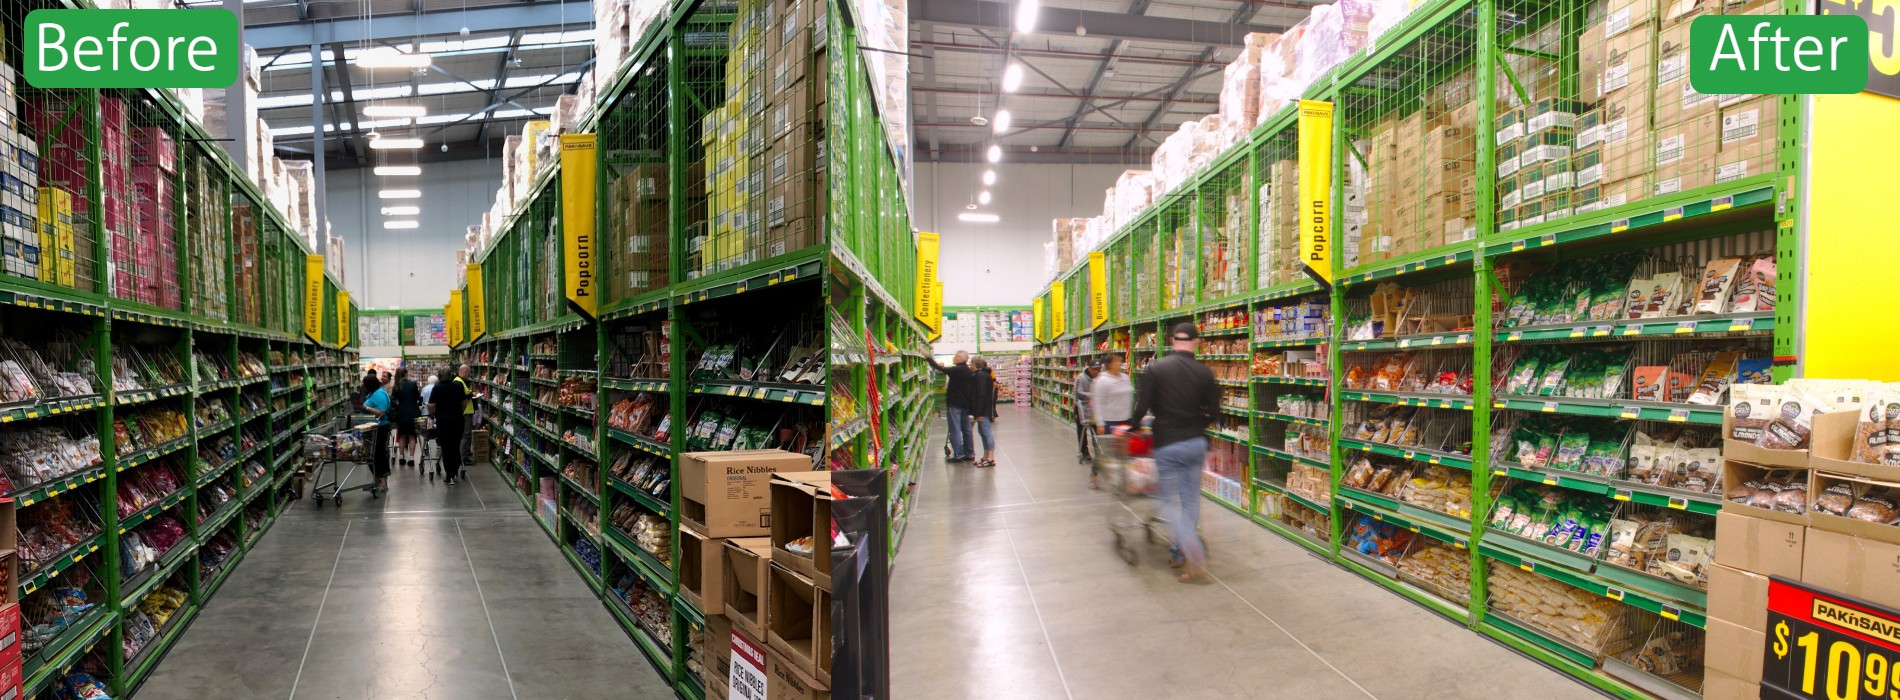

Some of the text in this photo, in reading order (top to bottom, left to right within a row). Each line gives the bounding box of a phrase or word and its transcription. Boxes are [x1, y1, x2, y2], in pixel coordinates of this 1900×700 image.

[1310, 200, 1327, 261] Popcorn
[576, 235, 592, 297] Popcorn
[919, 260, 934, 318] Confectionery
[1096, 292, 1104, 320] Biscuits
[308, 280, 320, 334] Confectionery
[473, 304, 481, 333] Biscuits
[1770, 424, 1800, 447] ALMONDS
[726, 465, 777, 475] Rice Nibbles
[731, 632, 765, 666] CHRISTMAS DEAL
[733, 660, 744, 680] RICE
[744, 669, 765, 697] NIBBLES
[774, 663, 805, 695] Rice Nibbles
